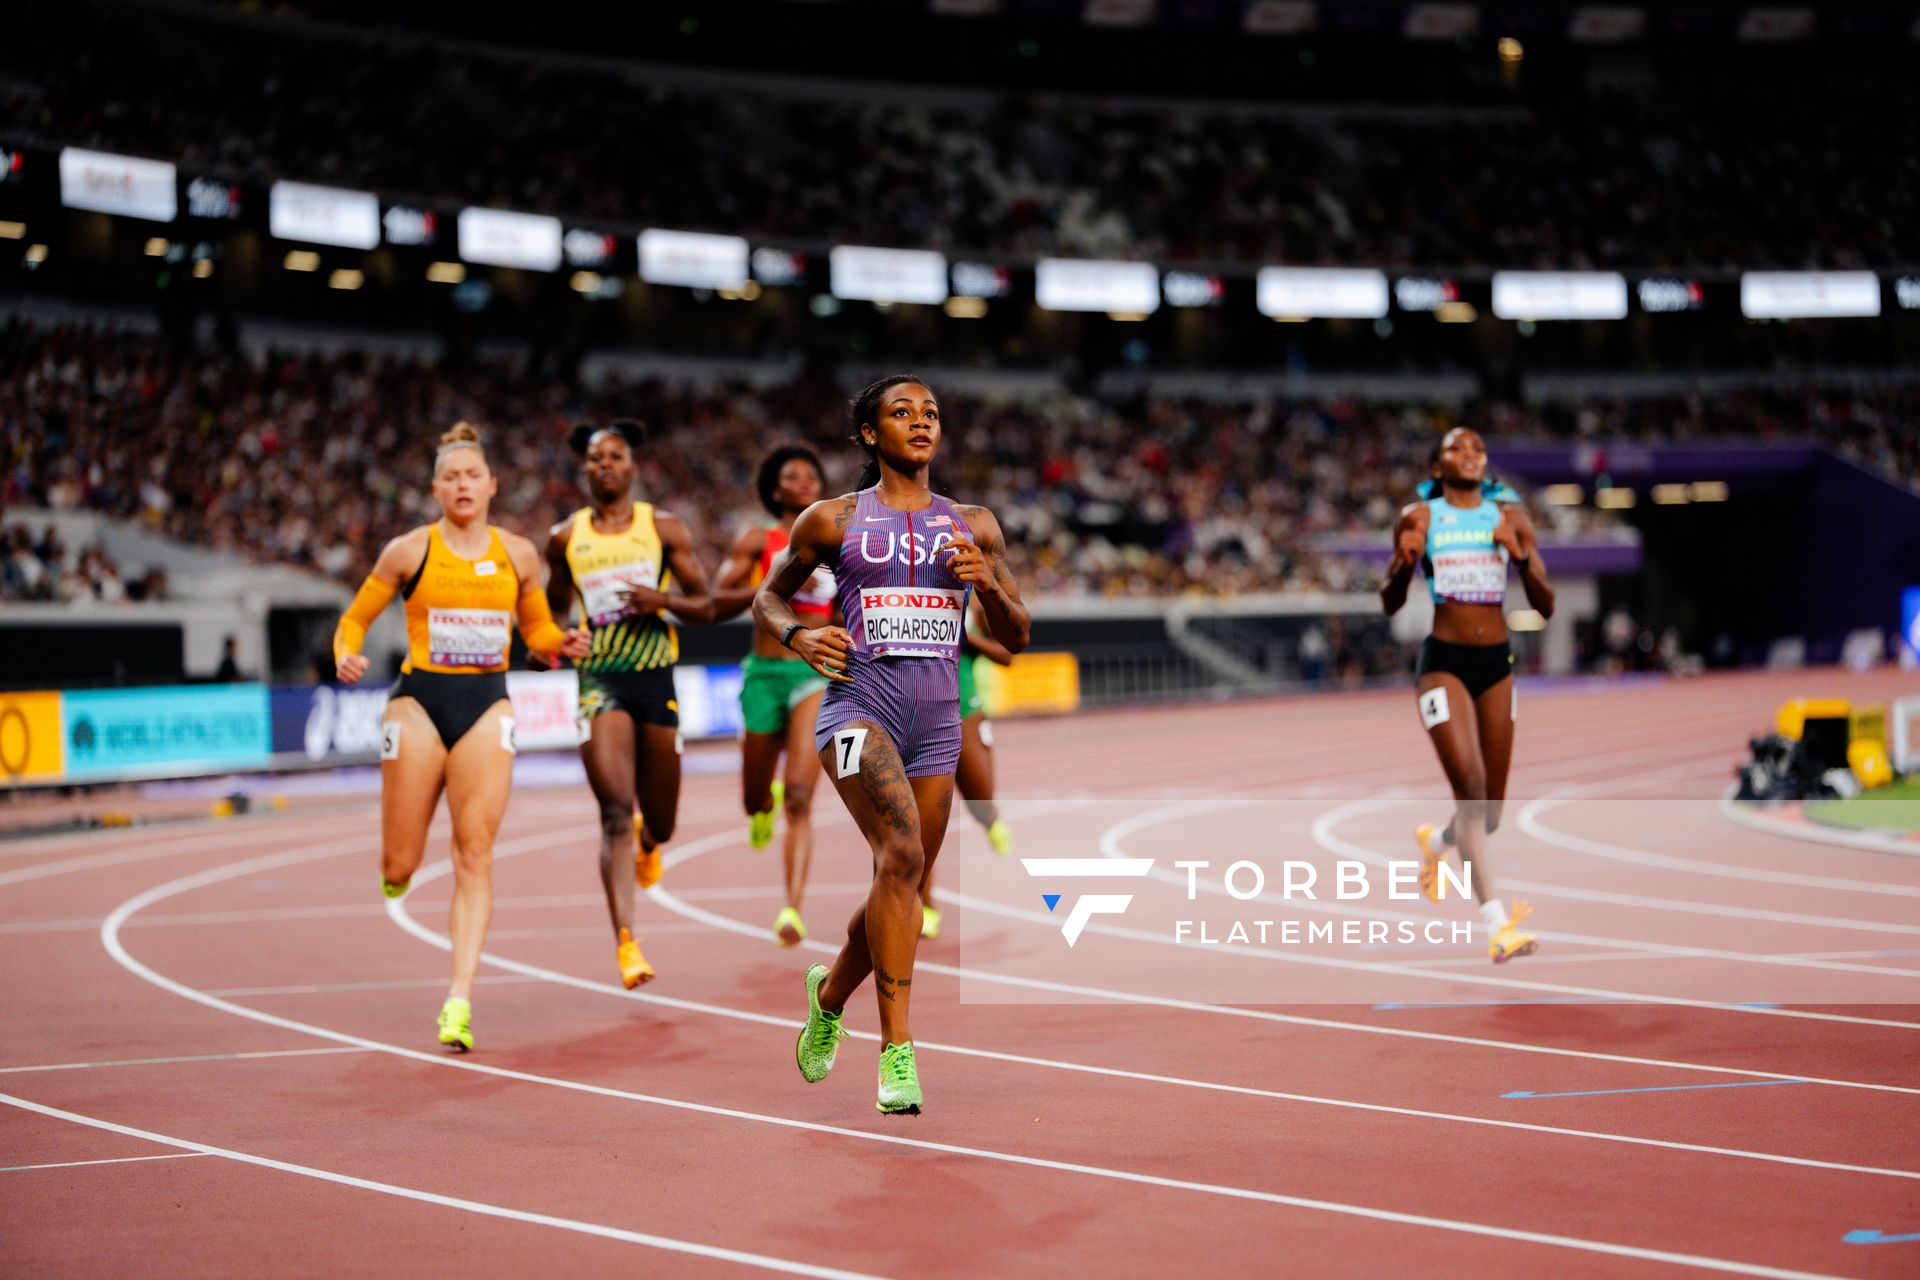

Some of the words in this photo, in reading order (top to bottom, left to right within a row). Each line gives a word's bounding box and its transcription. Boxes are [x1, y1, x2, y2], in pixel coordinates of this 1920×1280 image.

[1434, 531, 1494, 547] BAHAMA
[861, 531, 961, 565] USA
[1437, 555, 1504, 568] HONDA
[435, 576, 510, 591] GERMANY
[583, 567, 651, 590] HONDA
[863, 594, 961, 610] HONDA
[433, 615, 505, 626] HONDA
[867, 617, 958, 642] RICHARDSON
[1426, 699, 1437, 716] 4
[841, 736, 856, 770] 7
